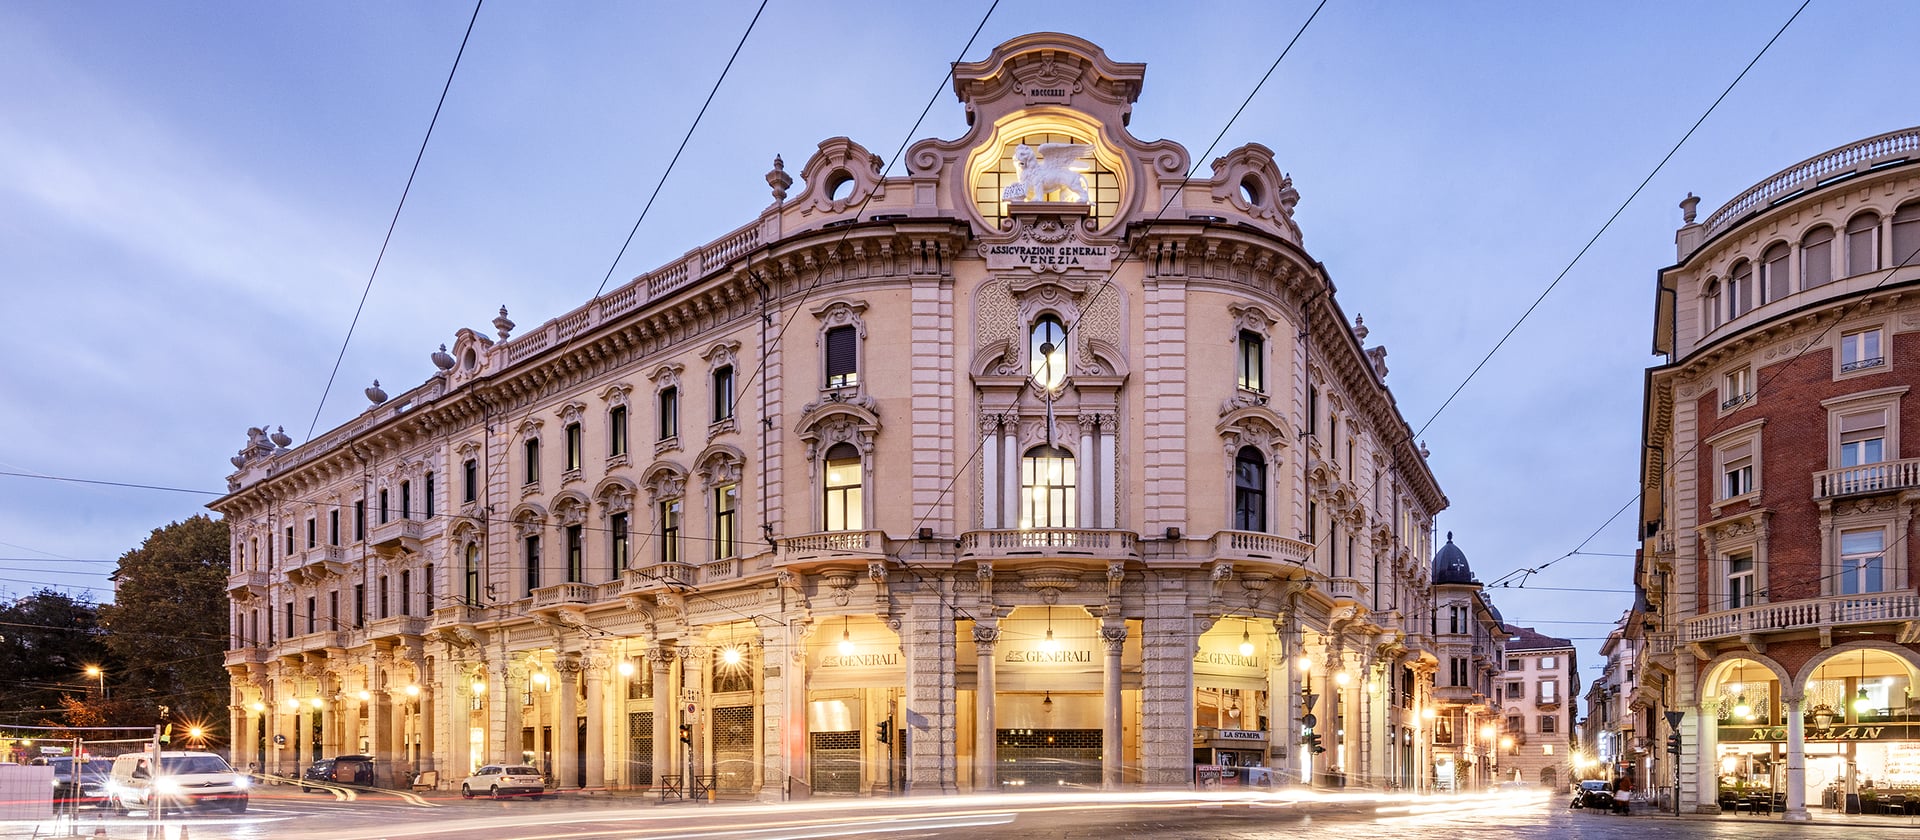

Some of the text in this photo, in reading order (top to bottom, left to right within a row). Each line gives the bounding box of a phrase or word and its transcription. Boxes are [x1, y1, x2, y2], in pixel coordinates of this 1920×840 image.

[990, 246, 1107, 256] ASSICVRAZIONI GENERALI
[1020, 255, 1080, 265] VENEZIA
[840, 653, 897, 666] GENERALI
[1026, 651, 1091, 662] GENERALI
[1209, 653, 1258, 667] GENERALI
[1234, 731, 1261, 739] STAMPA
[1749, 727, 1885, 740] NOMAN
